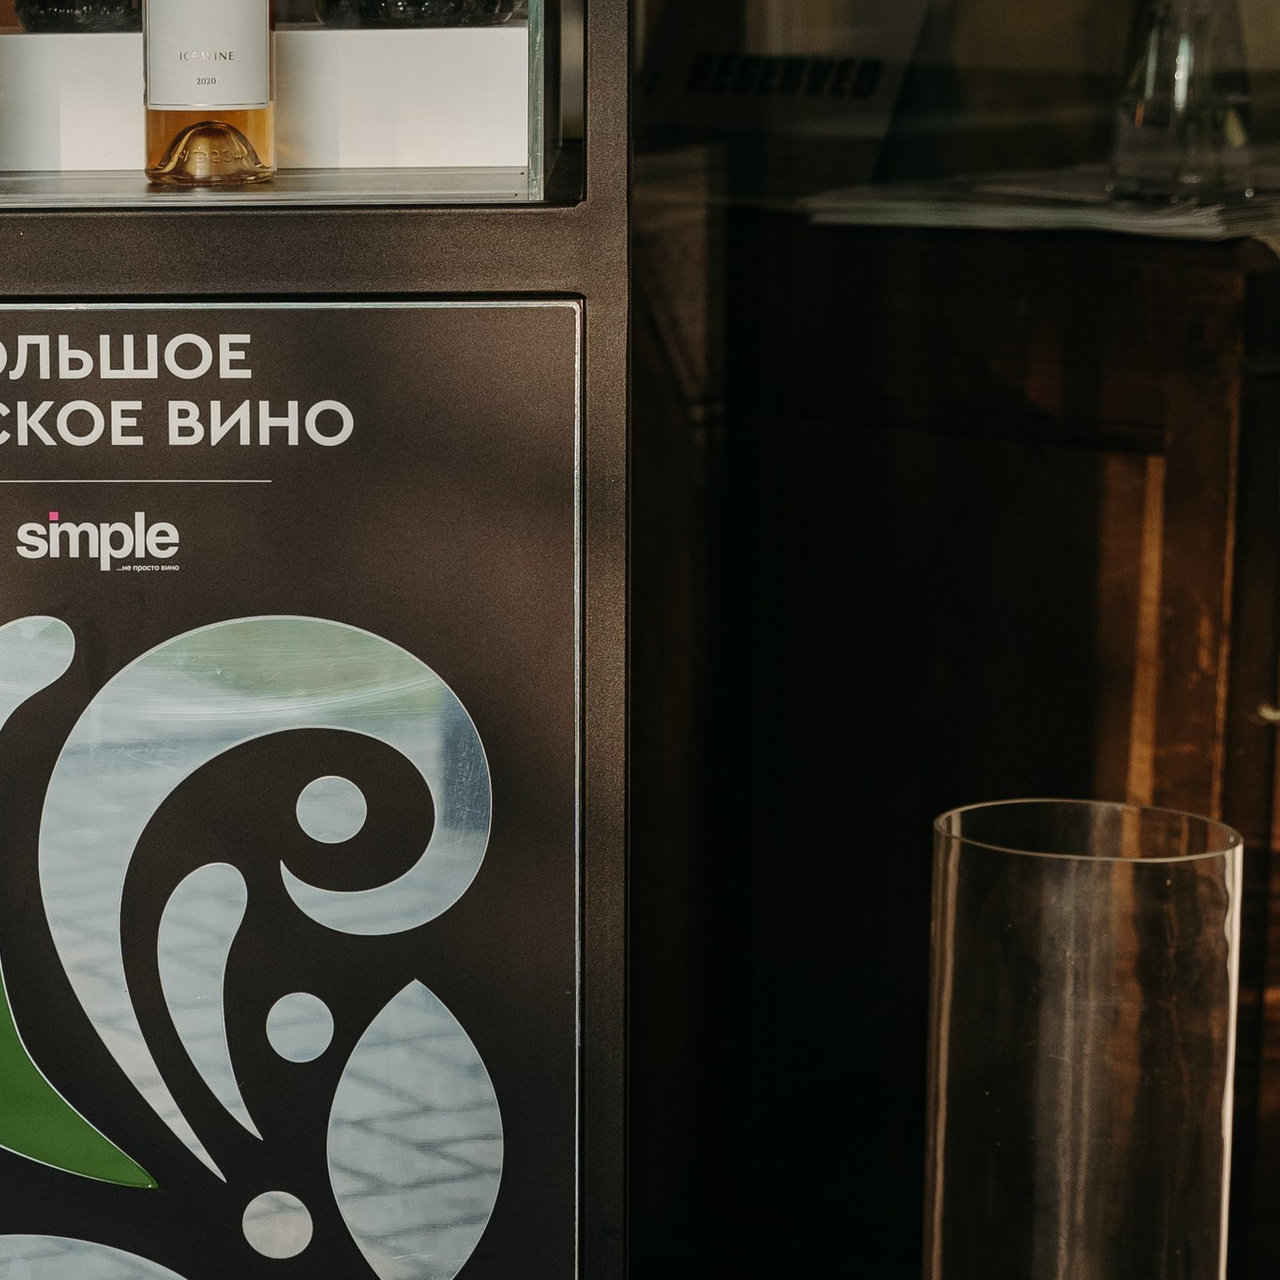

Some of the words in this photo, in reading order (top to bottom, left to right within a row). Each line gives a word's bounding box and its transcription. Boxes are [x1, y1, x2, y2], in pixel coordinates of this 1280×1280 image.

[196, 77, 217, 85] 2020
[685, 53, 883, 97] RESERVED
[168, 399, 355, 447] ВИНО
[16, 511, 180, 572] simple
